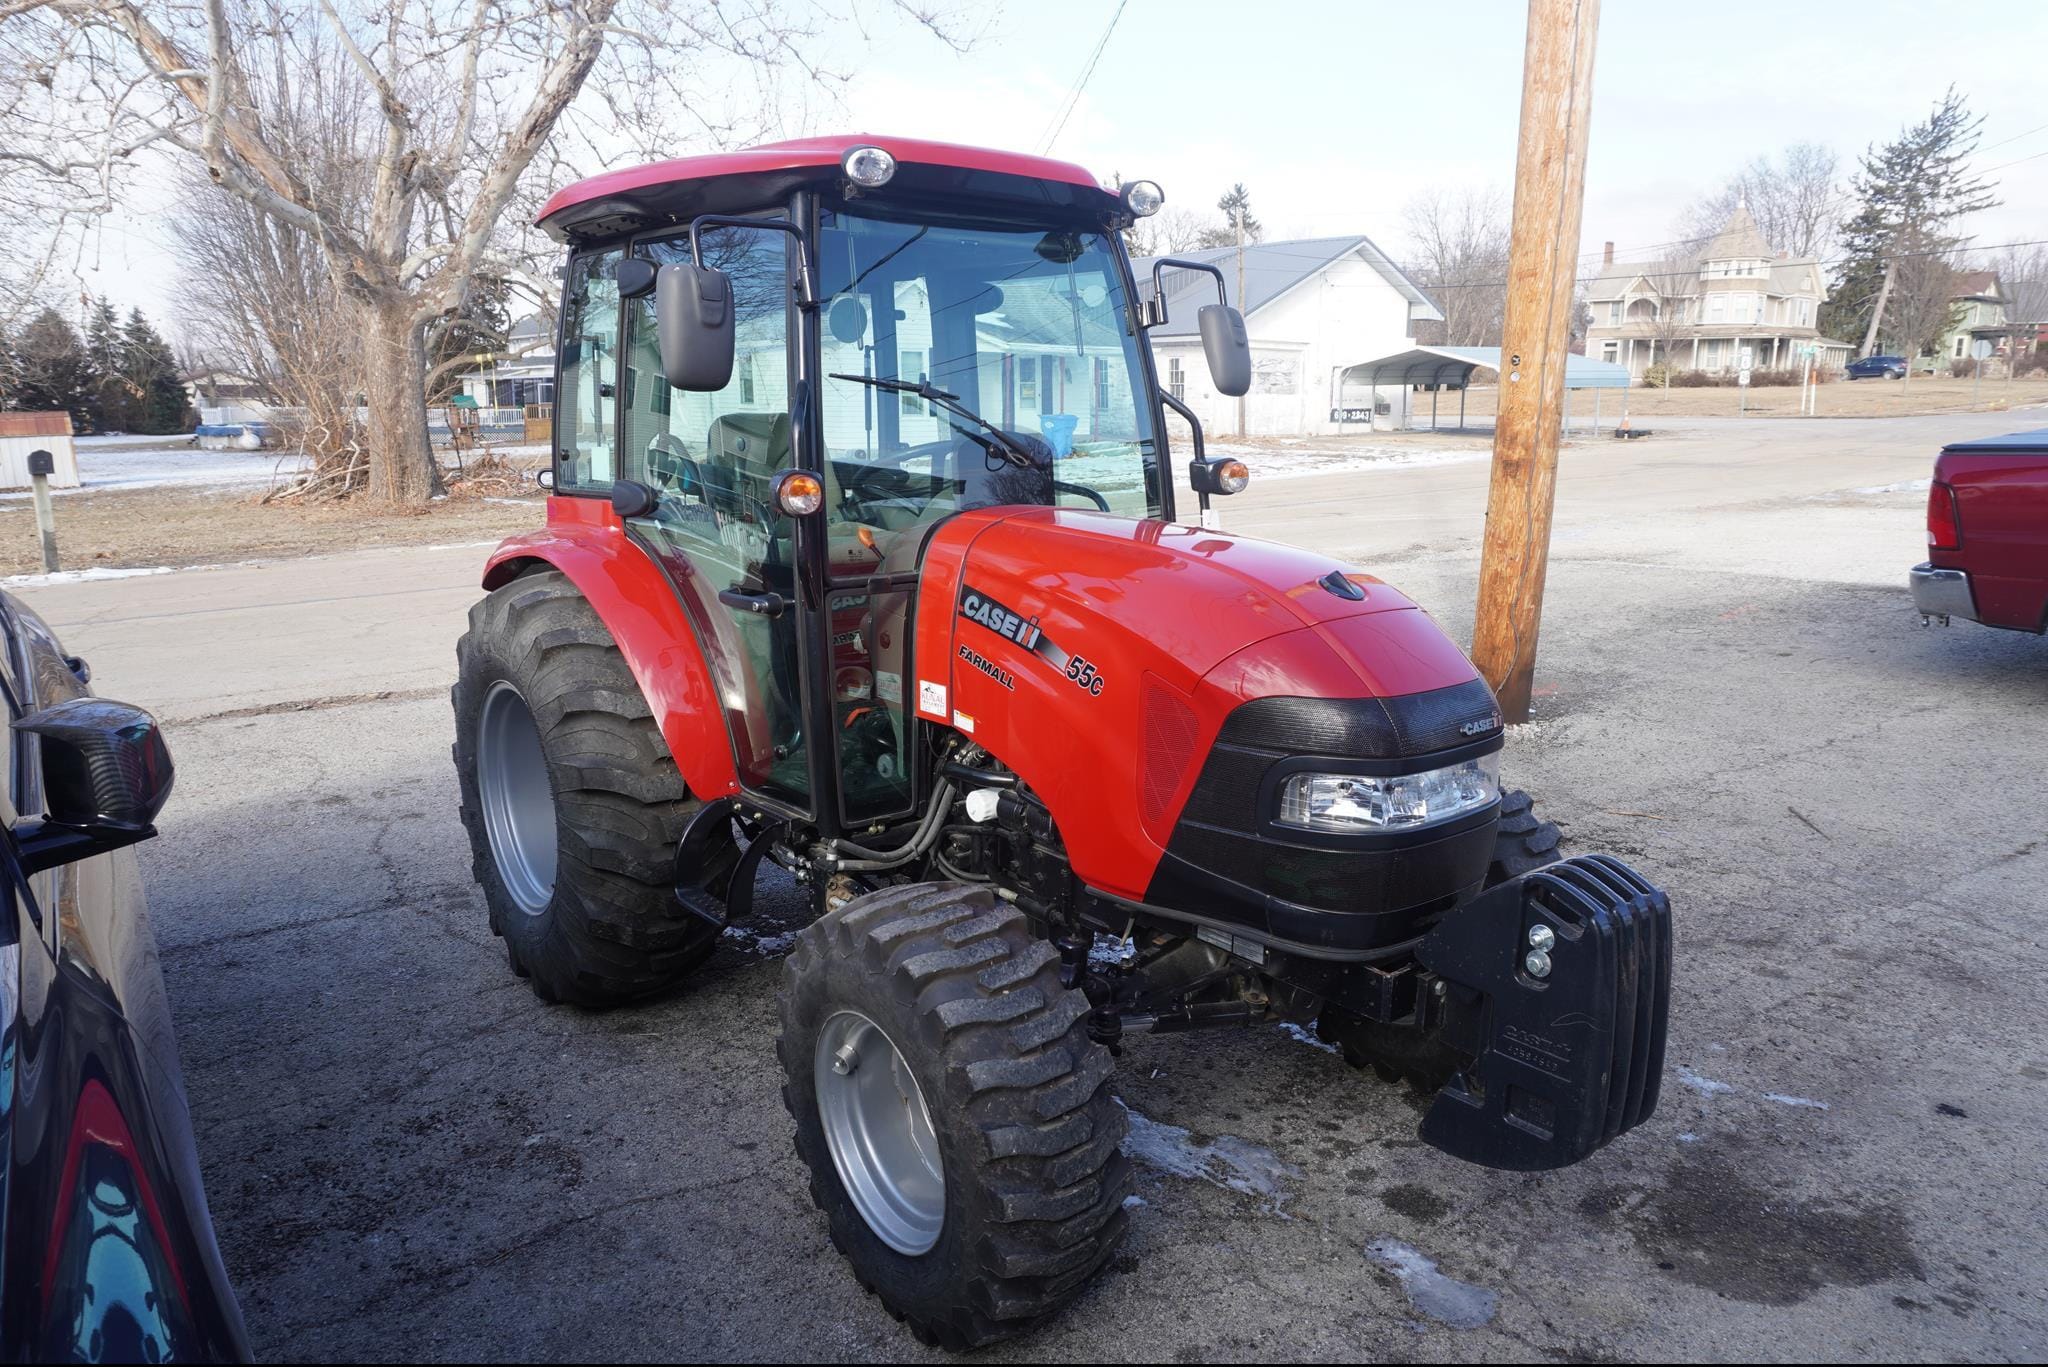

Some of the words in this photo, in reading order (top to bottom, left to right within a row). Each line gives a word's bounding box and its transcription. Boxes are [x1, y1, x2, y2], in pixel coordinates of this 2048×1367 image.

[963, 595, 1020, 639] CASE
[958, 645, 1015, 691] FARMALL
[1065, 655, 1104, 697] 55C
[1465, 717, 1493, 736] CASE
